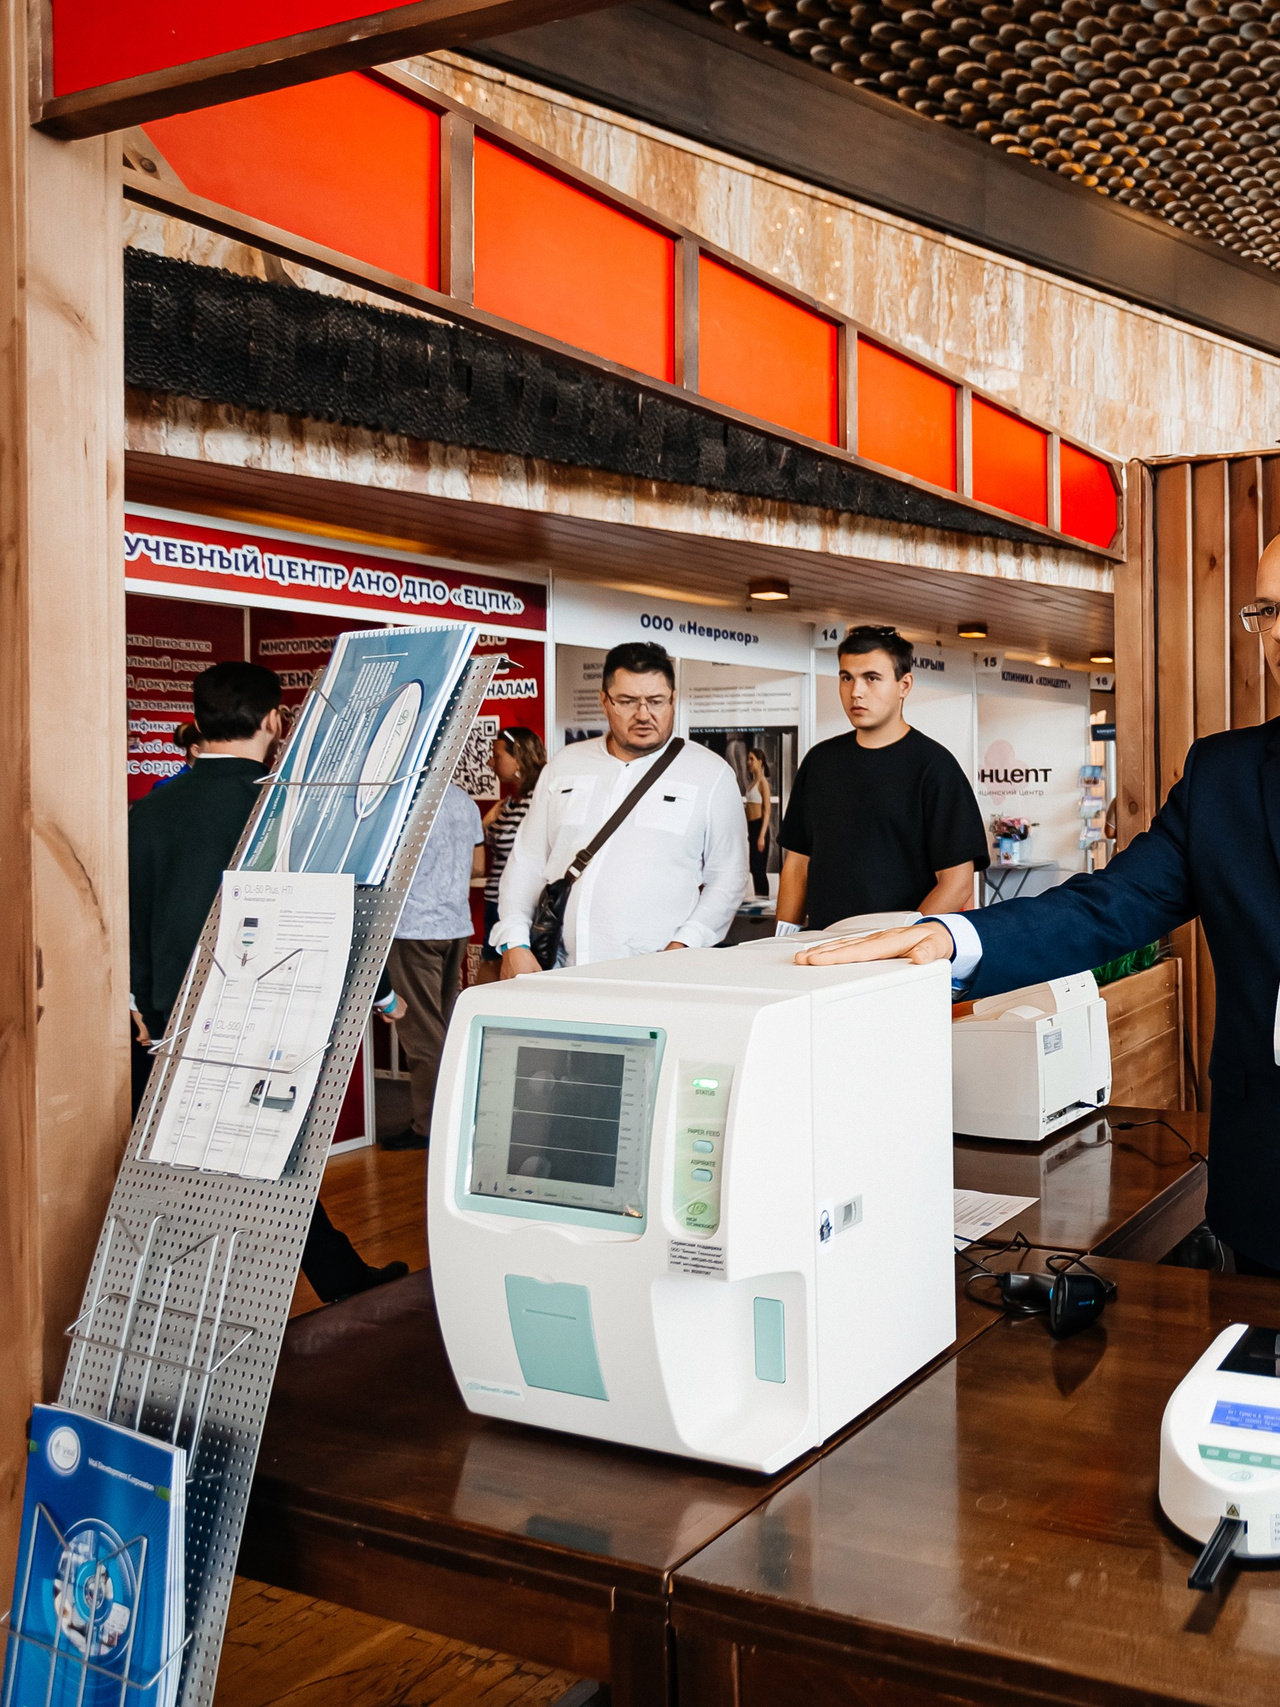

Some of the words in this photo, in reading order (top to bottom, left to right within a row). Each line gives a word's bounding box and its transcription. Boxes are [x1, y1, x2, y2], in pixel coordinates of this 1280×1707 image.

[124, 535, 260, 574] УЧЕБНЫЙ
[267, 558, 346, 585] ЦЕНТР
[352, 571, 397, 593] АНО
[403, 580, 447, 601] ДПО
[452, 588, 522, 611] «ЕЦПК»
[640, 613, 674, 632] ООО
[679, 620, 759, 646] «Неврокор»
[822, 628, 838, 641] 14
[983, 657, 997, 667] 15
[1001, 671, 1034, 684] КЛИНИКА
[1096, 677, 1108, 686] 16
[695, 1089, 716, 1097] STATUS
[687, 1128, 705, 1136] PAPER
[690, 1159, 716, 1168] ASPIRATE
